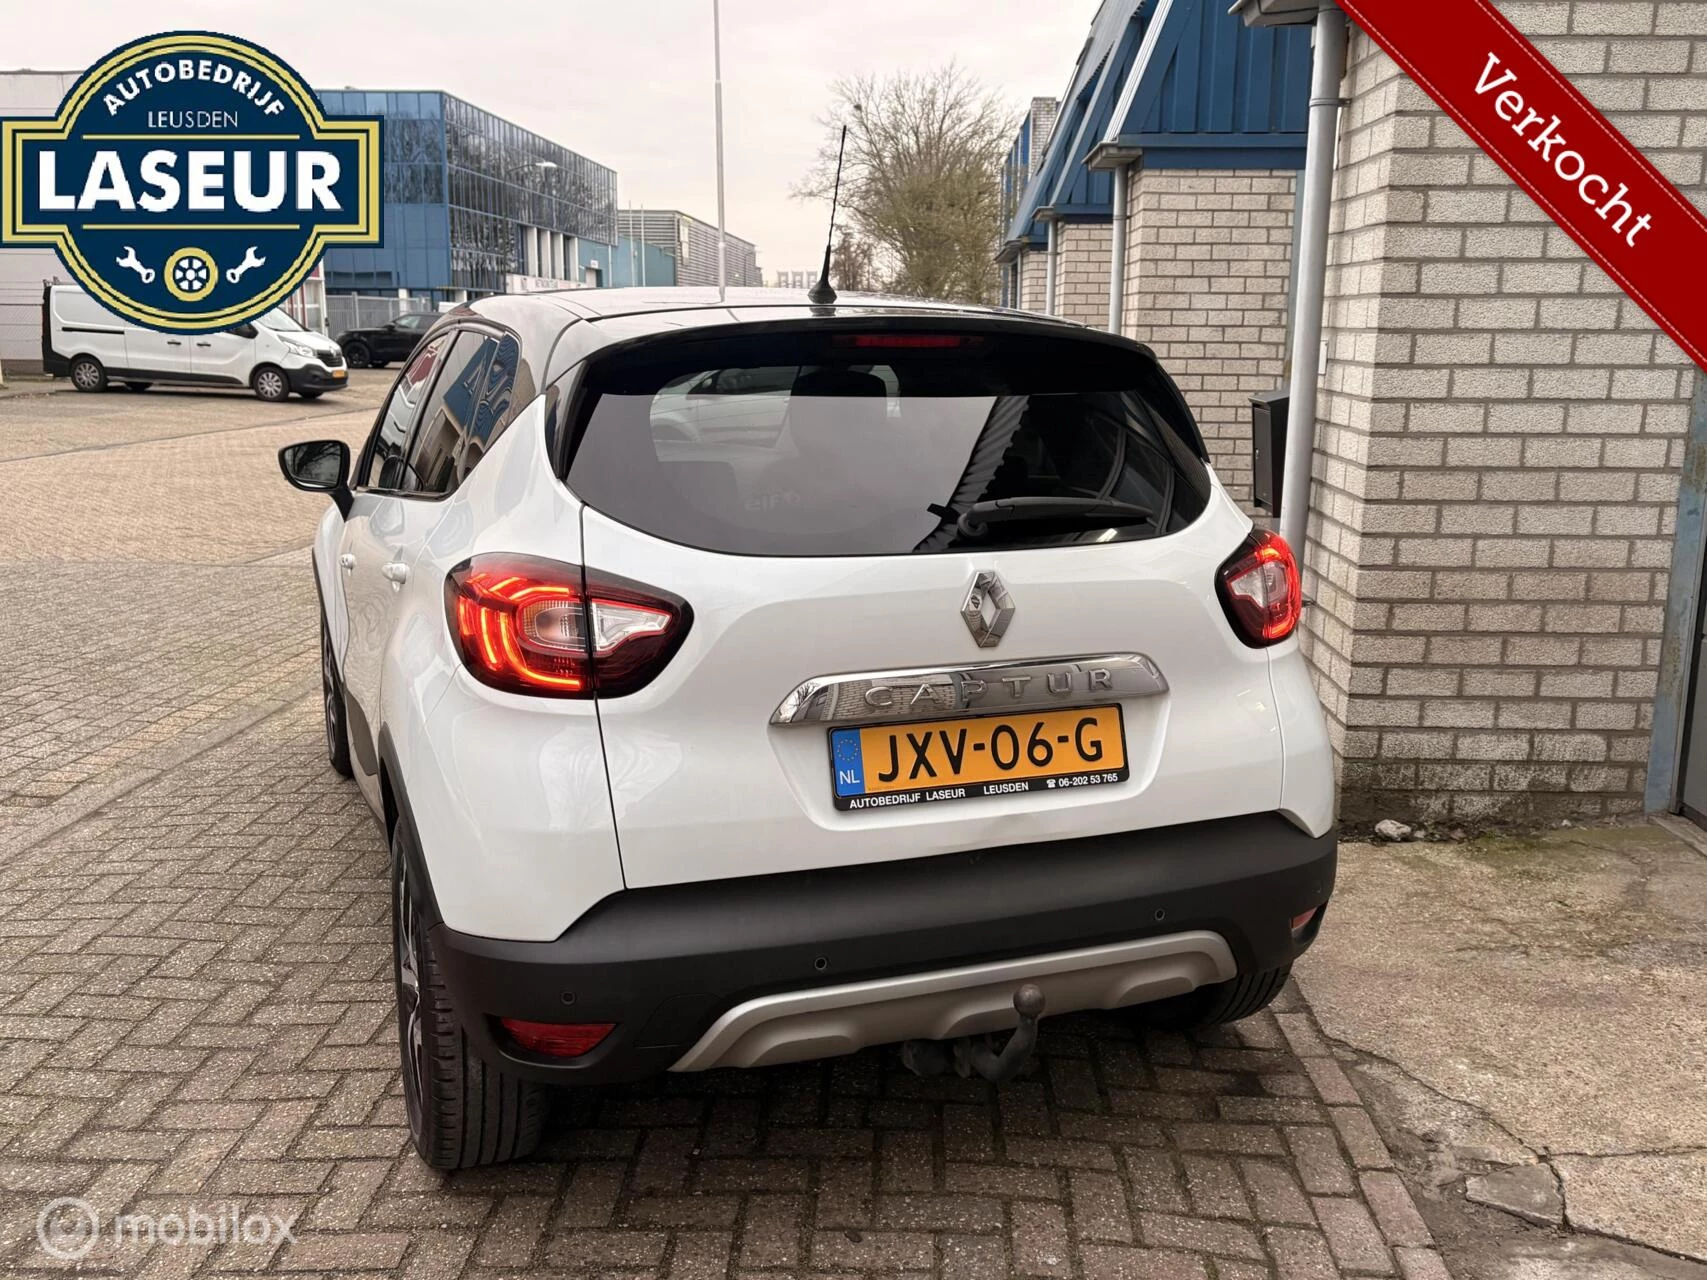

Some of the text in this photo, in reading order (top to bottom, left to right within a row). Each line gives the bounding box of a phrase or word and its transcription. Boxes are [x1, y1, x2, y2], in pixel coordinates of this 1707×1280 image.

[863, 667, 1113, 708] CAPTUR
[877, 717, 1104, 783] JXV-06-G
[839, 769, 860, 785] NL
[849, 772, 1118, 809] AUTOBEDRIJF LASEUR LEUSDEN 06-202 53 765
